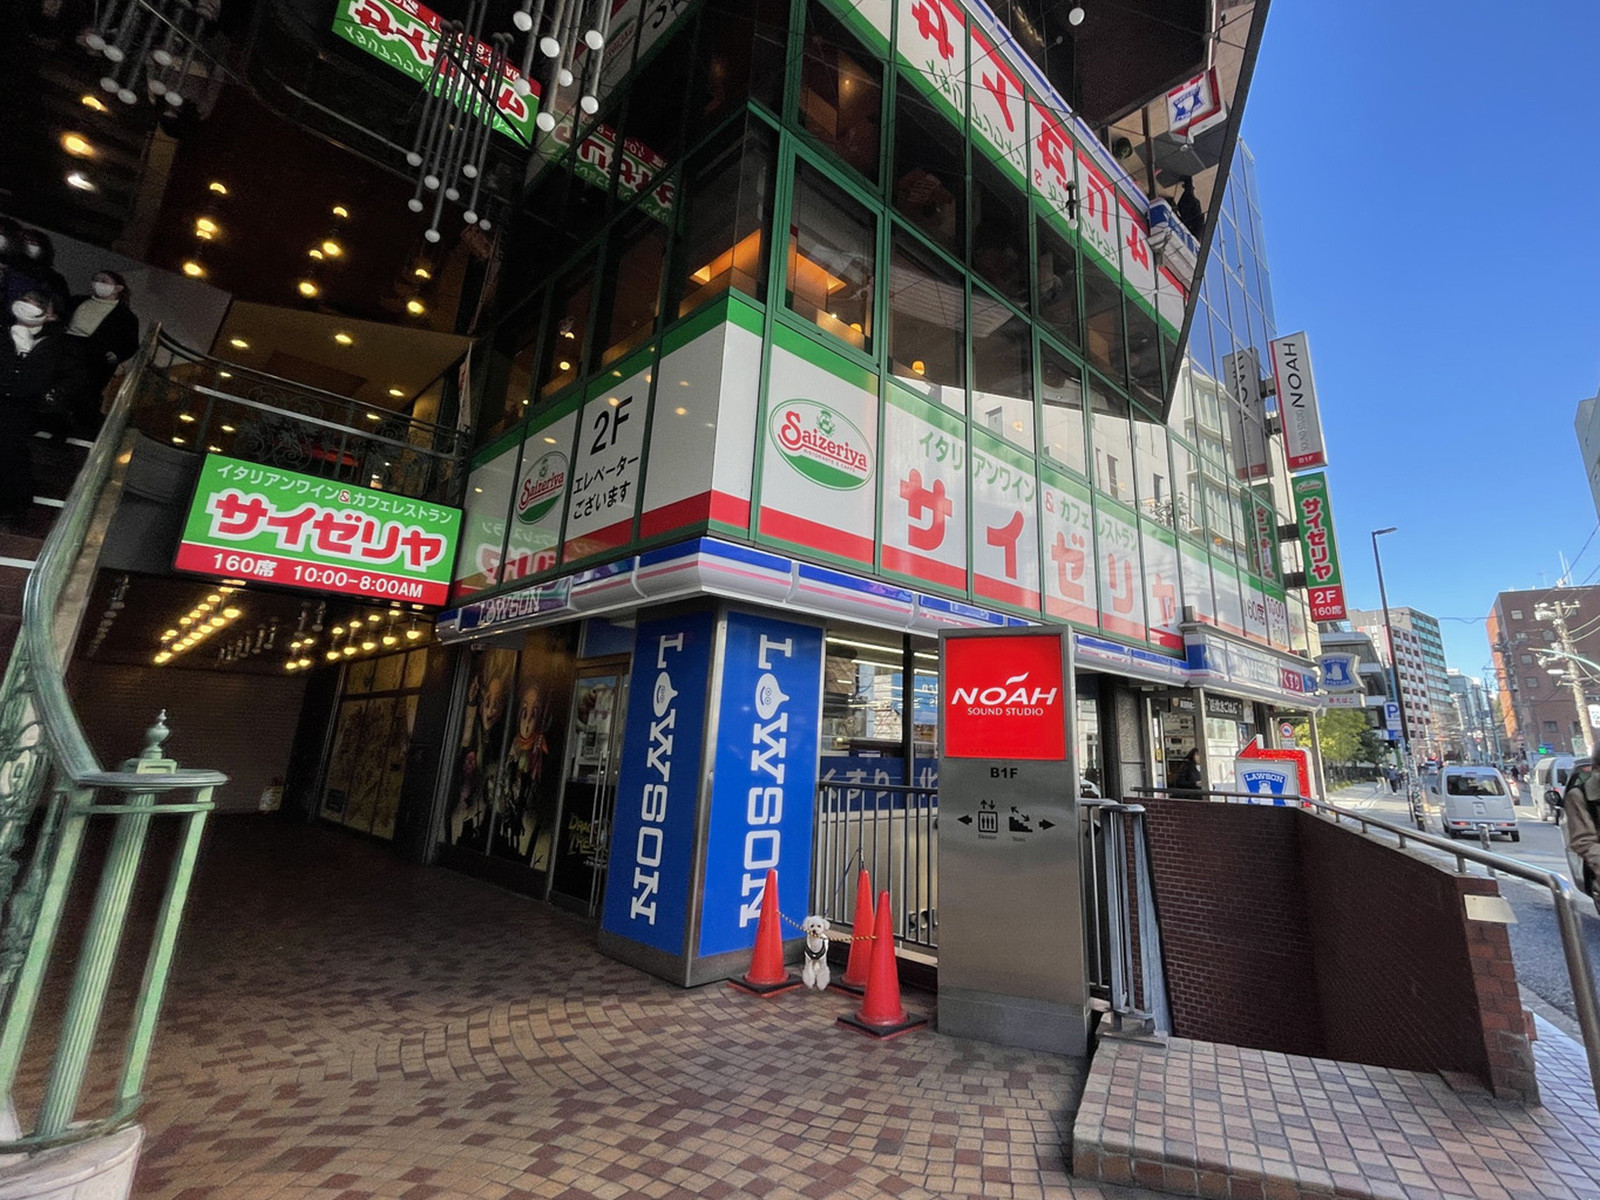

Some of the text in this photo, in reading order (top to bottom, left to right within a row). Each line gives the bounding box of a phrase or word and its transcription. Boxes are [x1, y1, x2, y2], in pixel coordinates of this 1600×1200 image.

[1283, 343, 1305, 408] NOAH
[591, 396, 633, 455] 2F
[779, 410, 868, 474] Saizeriya
[573, 456, 638, 494] エレベーター
[573, 481, 631, 519] ございます
[210, 491, 445, 570] サイゼリヤ
[1302, 497, 1332, 580] サイゼリヤ
[213, 553, 278, 578] 160席
[1314, 590, 1336, 604] 2F
[951, 687, 1058, 705] NOAH
[967, 707, 1043, 716] SOUND STUDIO
[1387, 704, 1399, 719] P
[990, 767, 1018, 779] B1F
[1245, 773, 1284, 783] LAWSON
